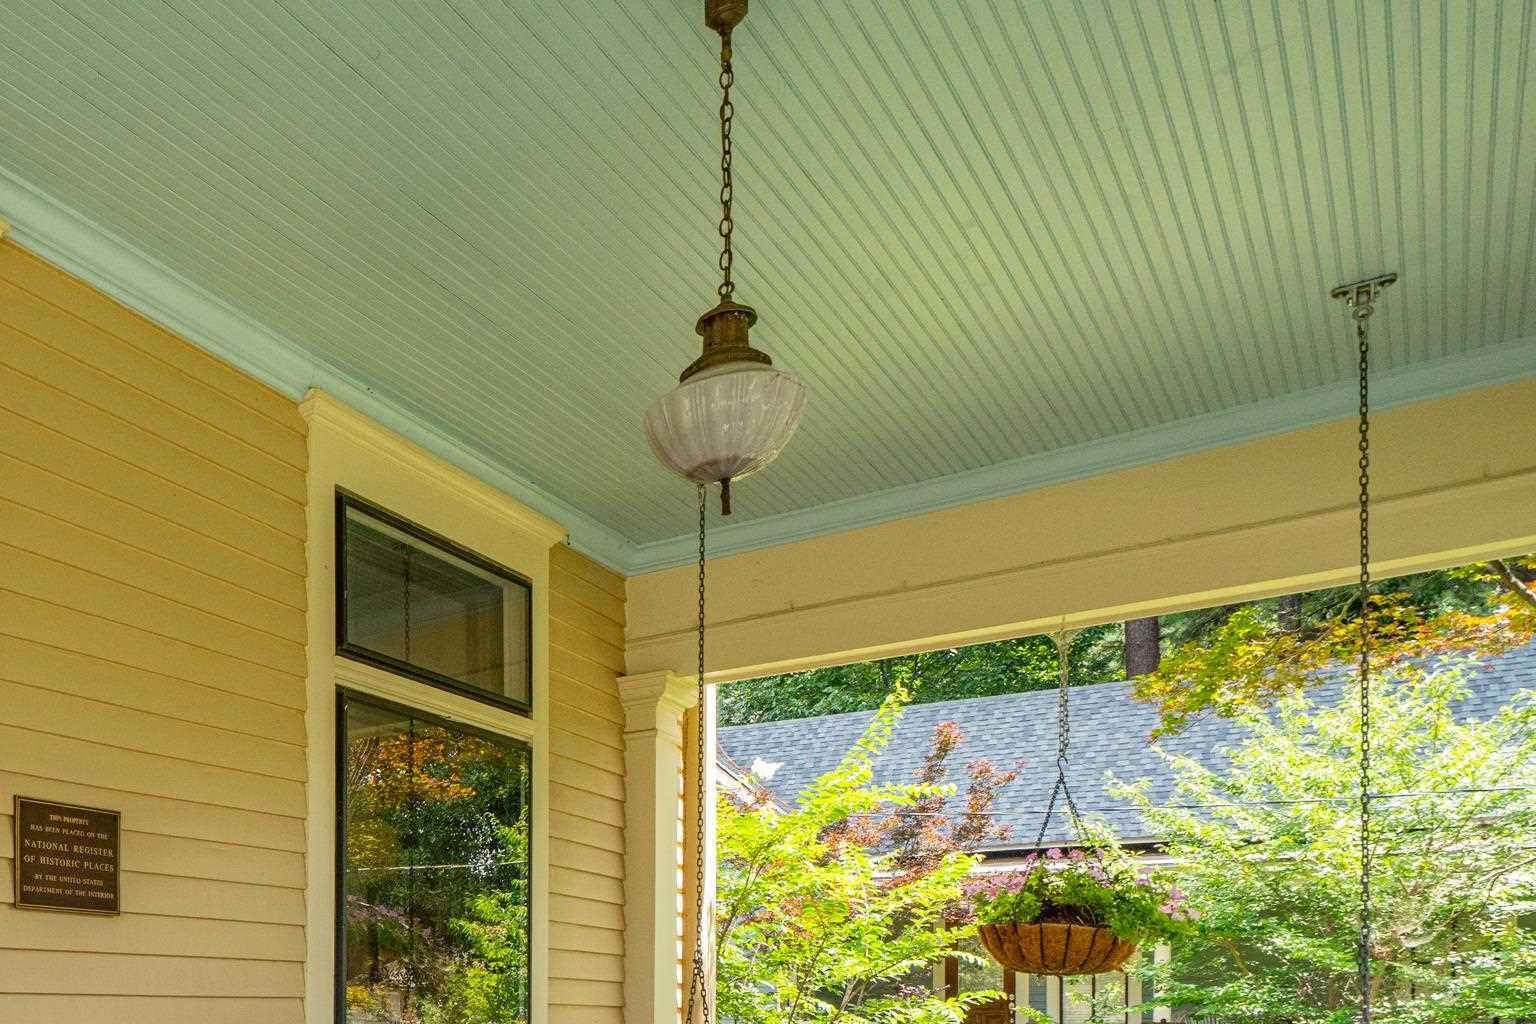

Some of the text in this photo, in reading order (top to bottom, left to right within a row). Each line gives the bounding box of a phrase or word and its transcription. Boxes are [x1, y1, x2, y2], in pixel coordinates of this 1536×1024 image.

[30, 824, 43, 832] HAS
[62, 827, 85, 837] PLACED
[97, 833, 109, 841] THE
[24, 839, 114, 858] NATIONAL REGISTER
[23, 854, 114, 872] OF HISTORIC PLACES
[45, 874, 57, 882] THE
[59, 876, 81, 885] UNITED
[83, 879, 104, 887] STATES
[23, 885, 63, 895] DEPARTMENT
[88, 891, 114, 899] INTERIOR
